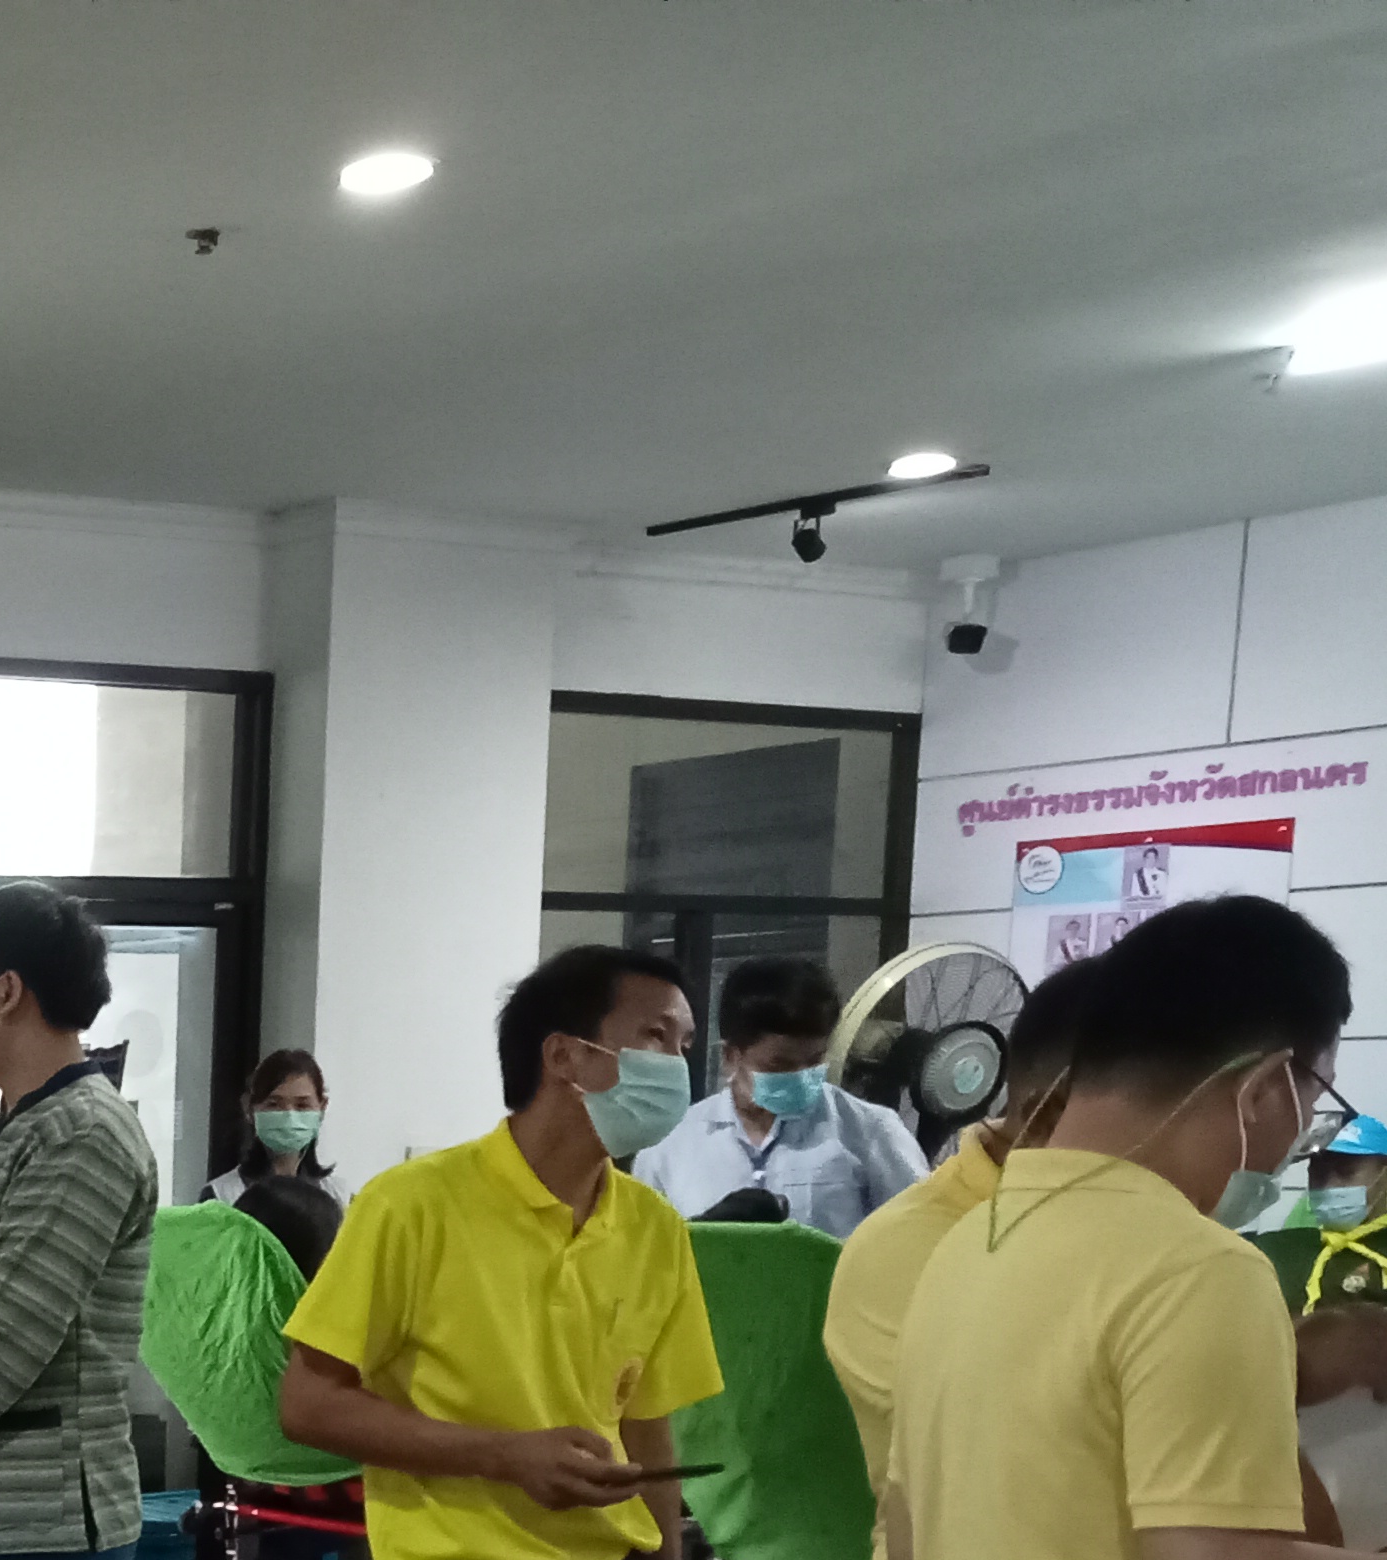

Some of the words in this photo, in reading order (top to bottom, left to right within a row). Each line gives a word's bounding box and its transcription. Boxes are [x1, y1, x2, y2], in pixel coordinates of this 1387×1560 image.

[957, 761, 1369, 837] ศูนย์ดำรงธรรมจังหวัดสกลนคร
